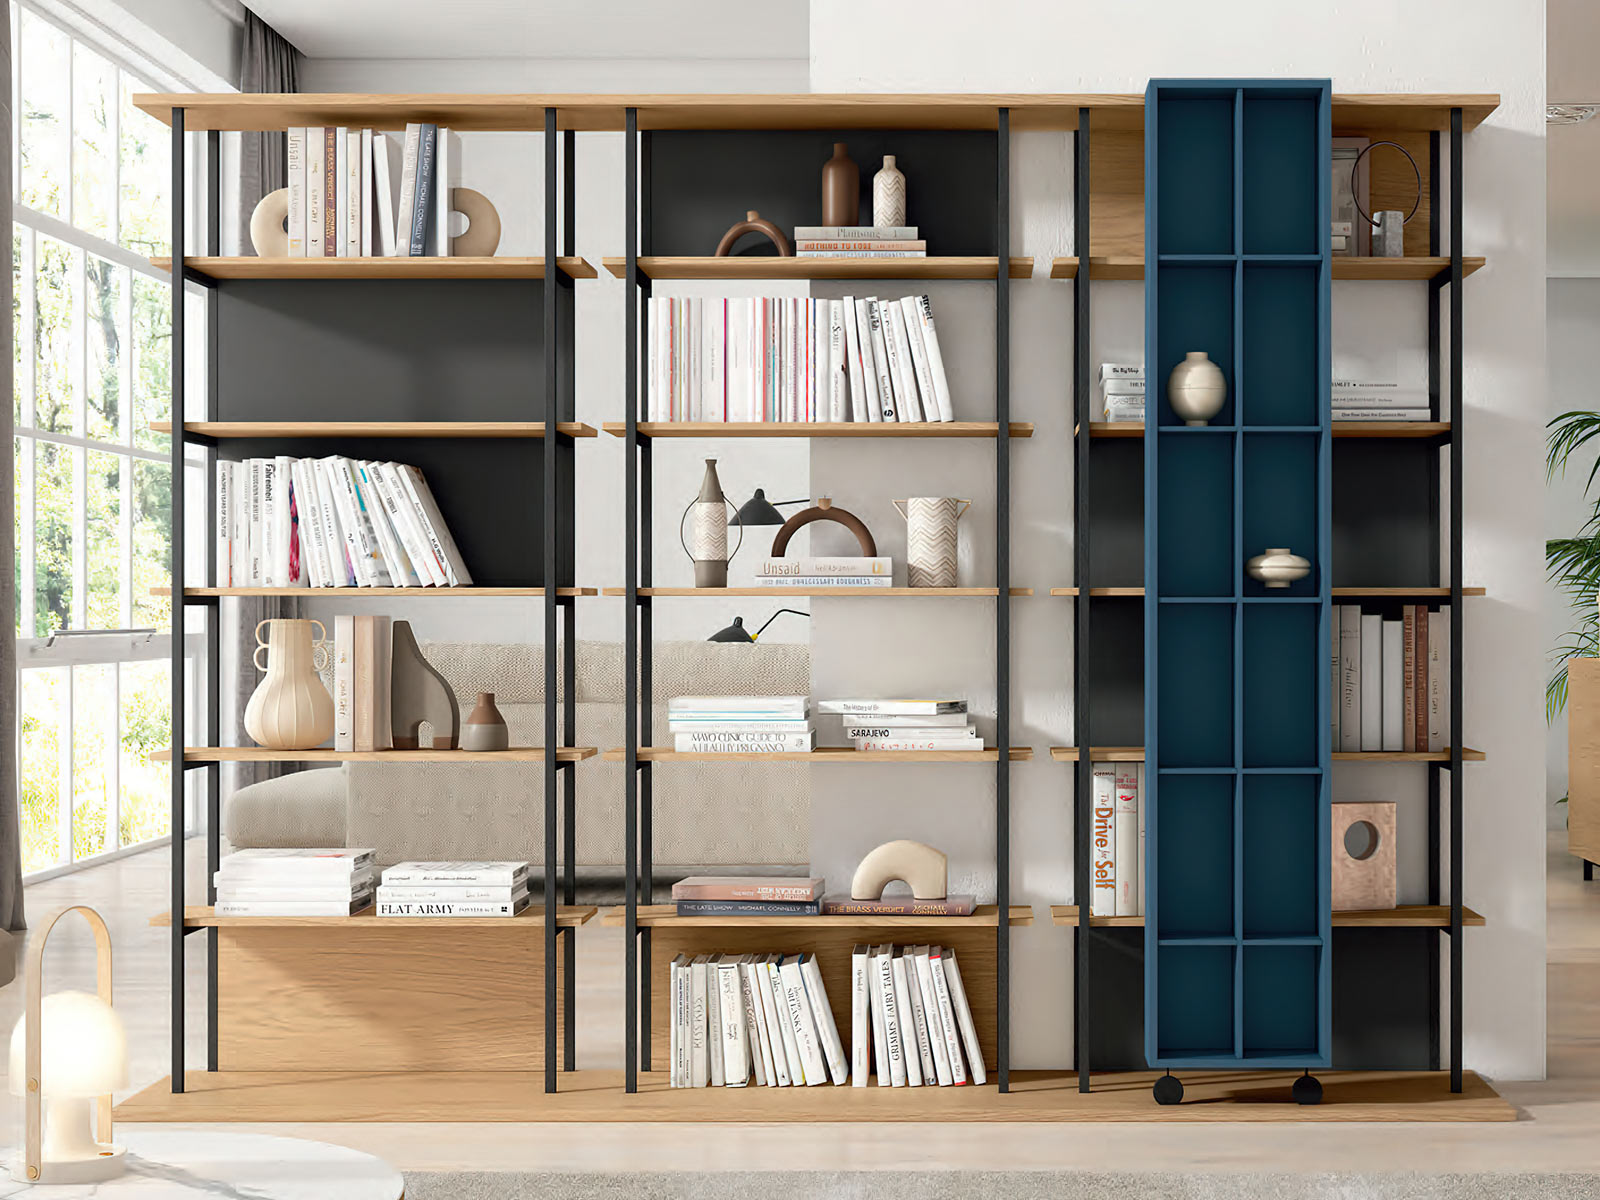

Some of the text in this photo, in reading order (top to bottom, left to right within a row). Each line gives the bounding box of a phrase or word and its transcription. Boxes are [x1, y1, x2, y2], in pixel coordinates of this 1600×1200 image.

[289, 135, 302, 170] Unsaid
[921, 294, 934, 320] street
[265, 463, 273, 501] Fahrenheit
[763, 562, 800, 575] Unsaid
[851, 729, 890, 738] SARAJEVO
[1095, 807, 1114, 847] Drive
[1095, 861, 1115, 889] Self
[381, 904, 412, 914] FLAT
[416, 904, 455, 914] ARMY
[828, 905, 845, 913] THE
